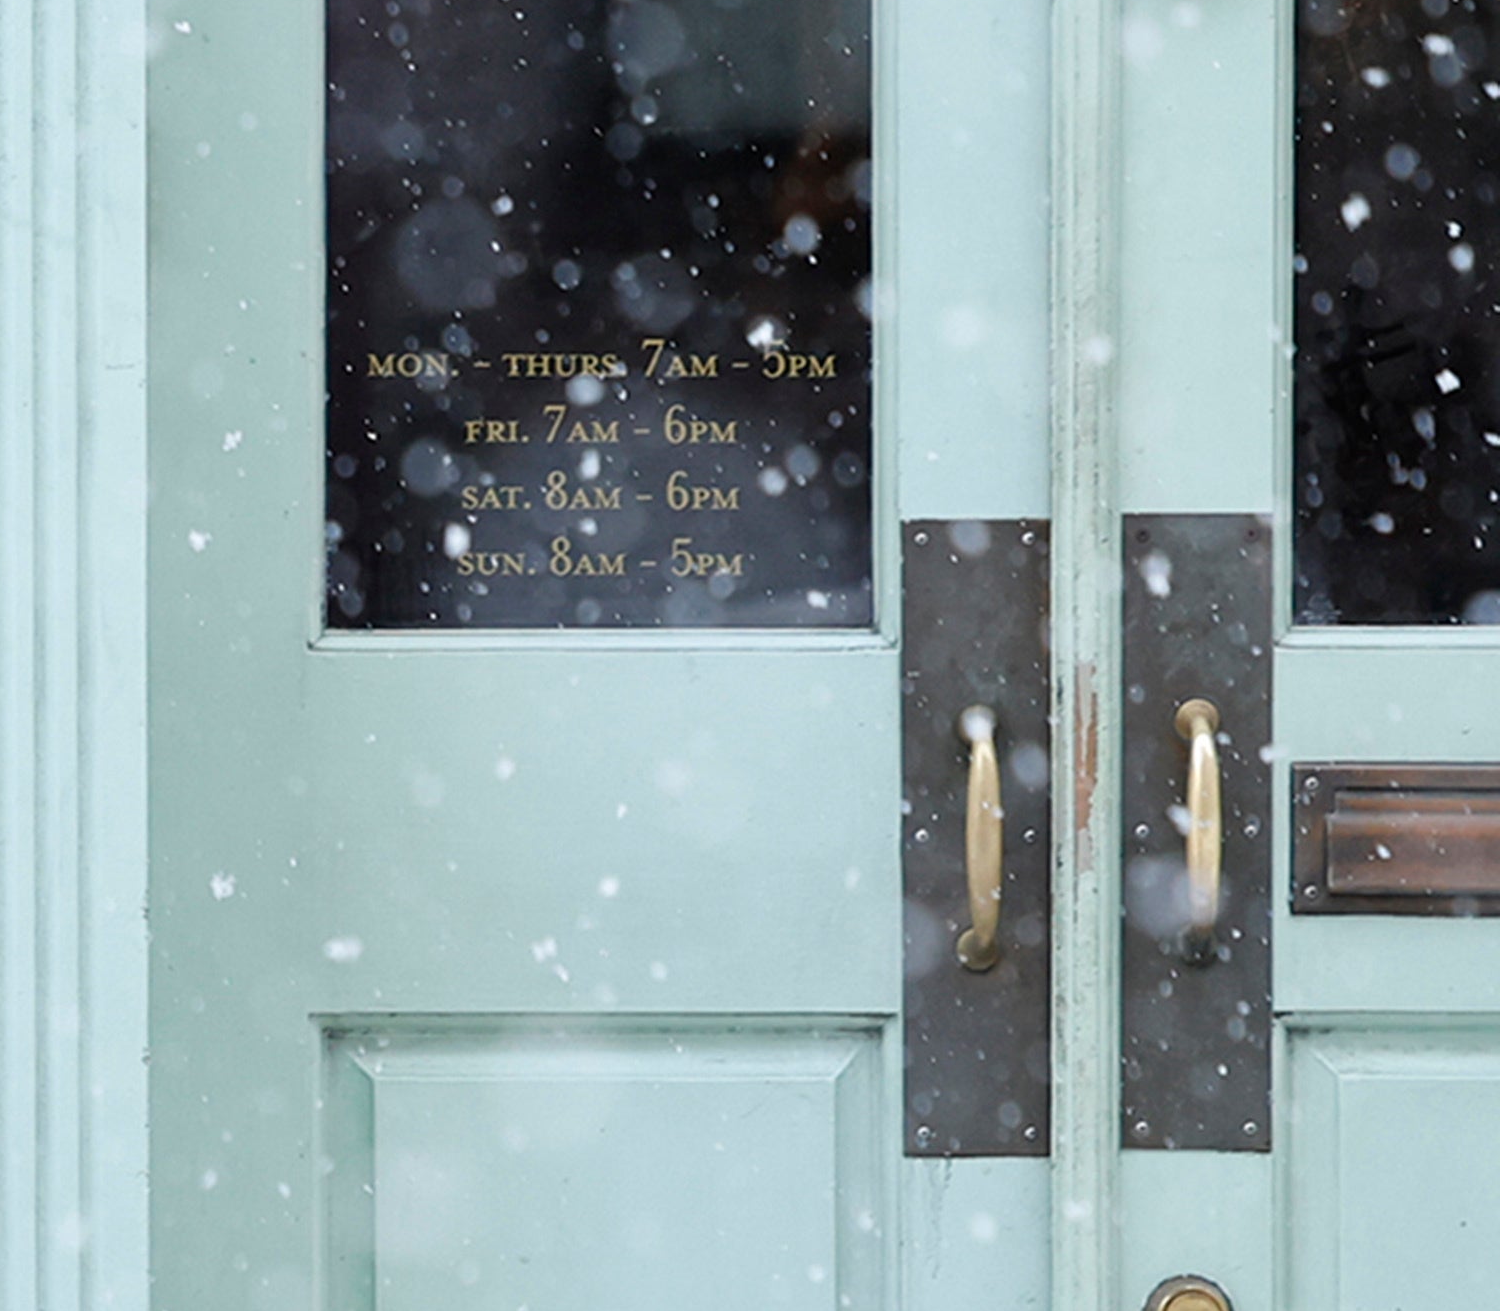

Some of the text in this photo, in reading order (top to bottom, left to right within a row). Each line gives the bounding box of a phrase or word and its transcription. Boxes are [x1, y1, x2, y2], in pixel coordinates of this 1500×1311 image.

[367, 353, 459, 377] MON.
[641, 339, 718, 378] 7AM
[762, 339, 837, 379] 5PM
[464, 420, 529, 443] FRI.
[543, 404, 619, 443] 7AM
[664, 404, 737, 444] 6PM
[461, 486, 532, 510] SAT.
[545, 470, 621, 510] 8AM
[666, 470, 740, 511] 6PM
[457, 553, 537, 576] SUN.
[550, 536, 627, 577] 8AM
[671, 538, 743, 577] 5PM
